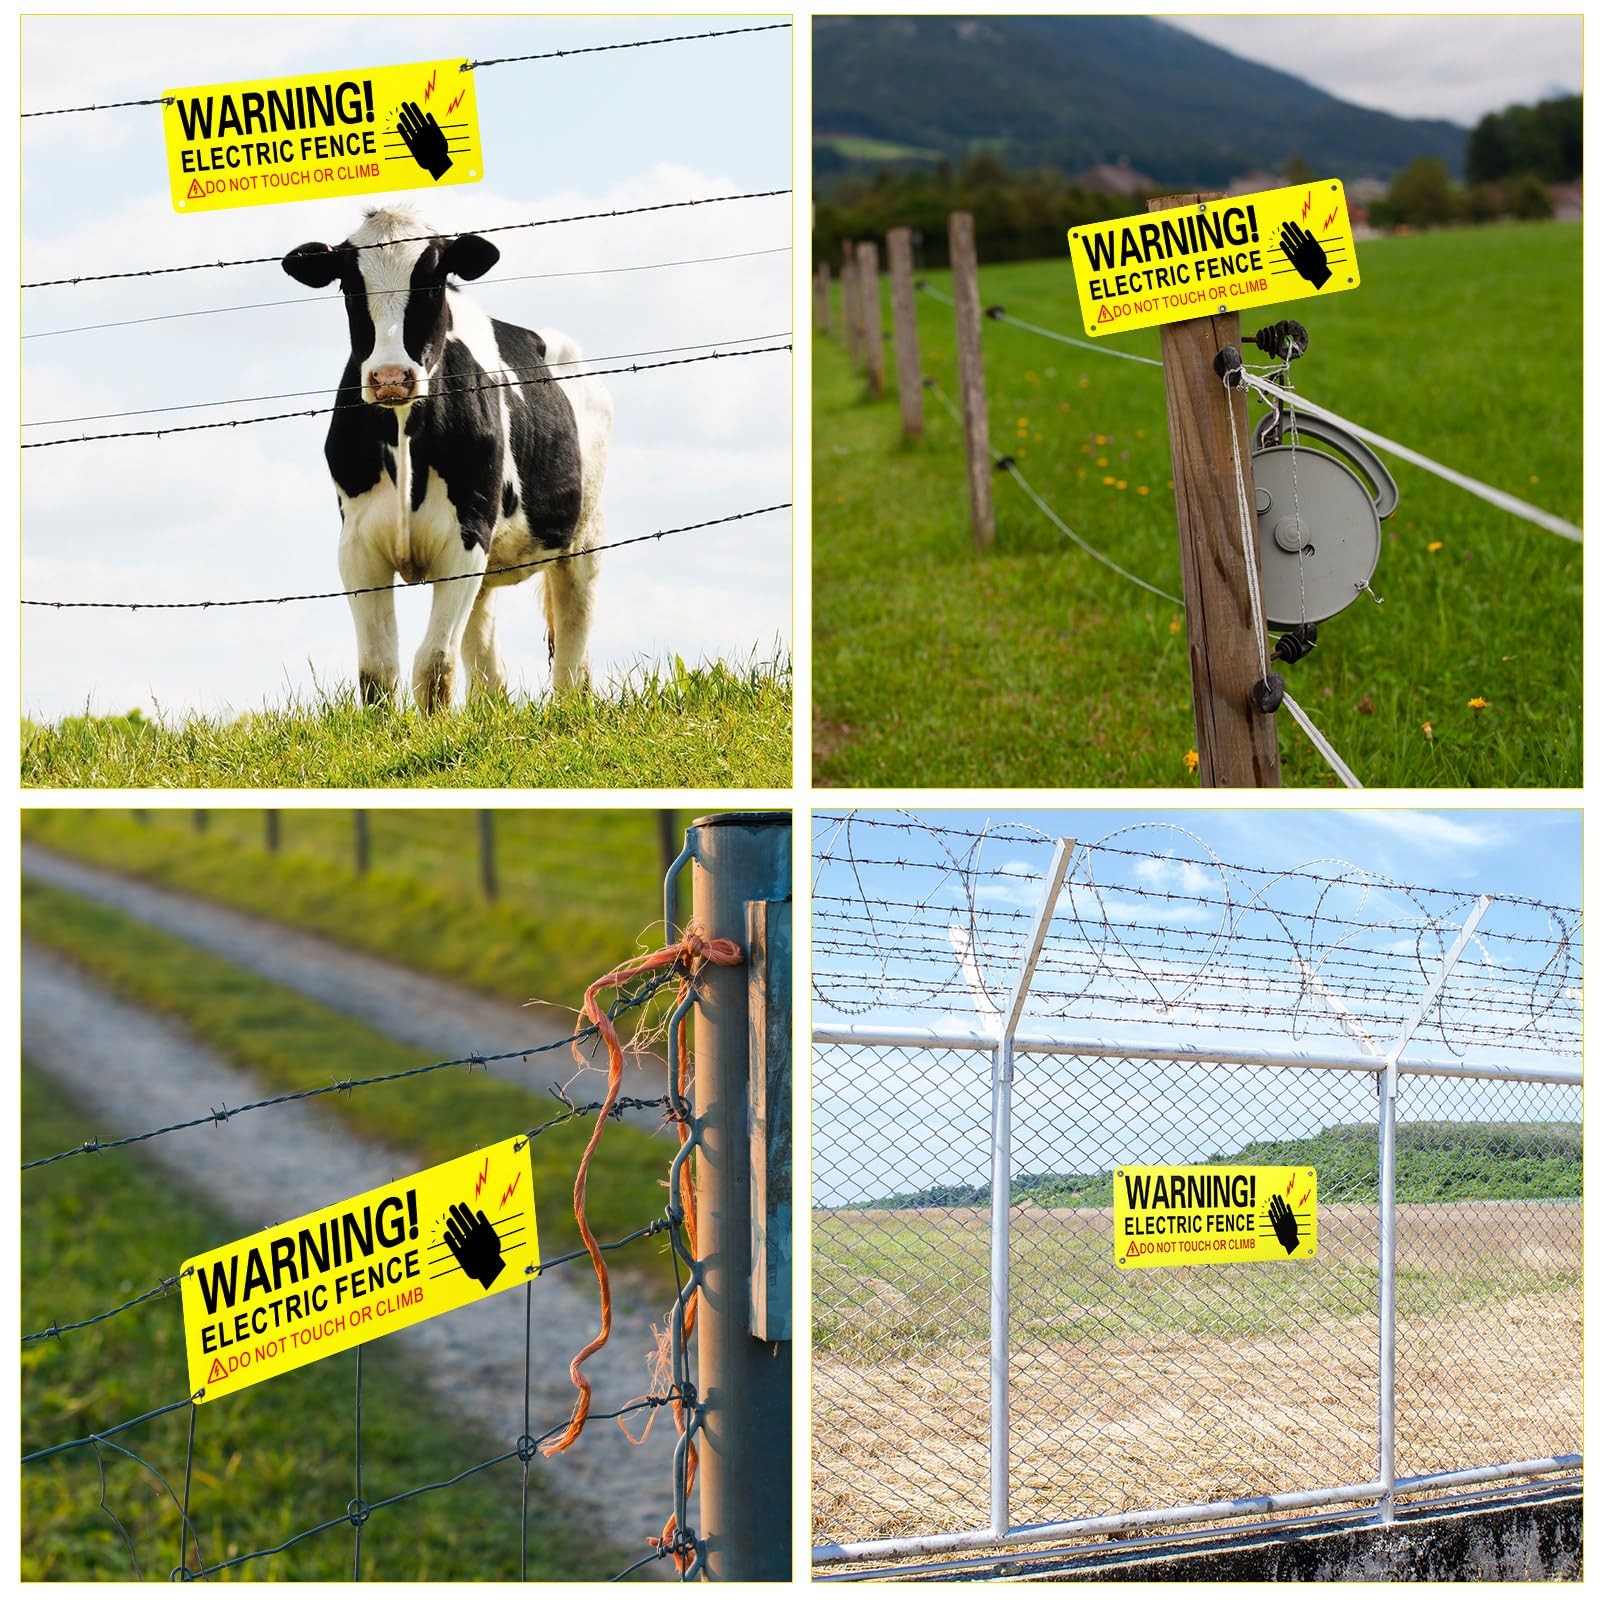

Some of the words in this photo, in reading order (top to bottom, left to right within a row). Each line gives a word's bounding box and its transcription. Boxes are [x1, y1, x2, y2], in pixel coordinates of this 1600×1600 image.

[177, 80, 375, 141] WARNING!
[181, 138, 295, 173] ELECTRIC
[300, 131, 377, 160] FENCE
[205, 180, 226, 194] DO
[229, 175, 258, 192] NOT
[262, 170, 310, 188] TOUCH
[313, 168, 334, 183] OR
[337, 163, 380, 180] CLIMB
[1082, 205, 1259, 272] WARNING!
[1089, 264, 1190, 301] ELECTRIC
[1195, 250, 1263, 281] FENCE
[1113, 304, 1131, 318] DO
[1134, 298, 1160, 314] NOT
[1163, 290, 1206, 307] TOUCH
[1208, 285, 1228, 300] OR
[1230, 278, 1268, 296] CLIMB
[1125, 1175, 1256, 1209] WARNING!
[1125, 1215, 1202, 1235] ELECTRIC
[1206, 1214, 1255, 1232] FENCE
[1140, 1242, 1154, 1254] DO
[1157, 1241, 1177, 1253] NOT
[1179, 1240, 1211, 1252] TOUCH
[1213, 1239, 1227, 1250] OR
[1228, 1238, 1256, 1250] CLIMB
[197, 1189, 419, 1315] WARNING!
[201, 1284, 328, 1355] ELECTRIC
[335, 1249, 421, 1304] FENCE
[228, 1351, 251, 1373] DO
[255, 1337, 288, 1363] NOT
[290, 1315, 346, 1349] TOUCH
[350, 1306, 373, 1327] OR
[376, 1286, 424, 1317] CLIMB
